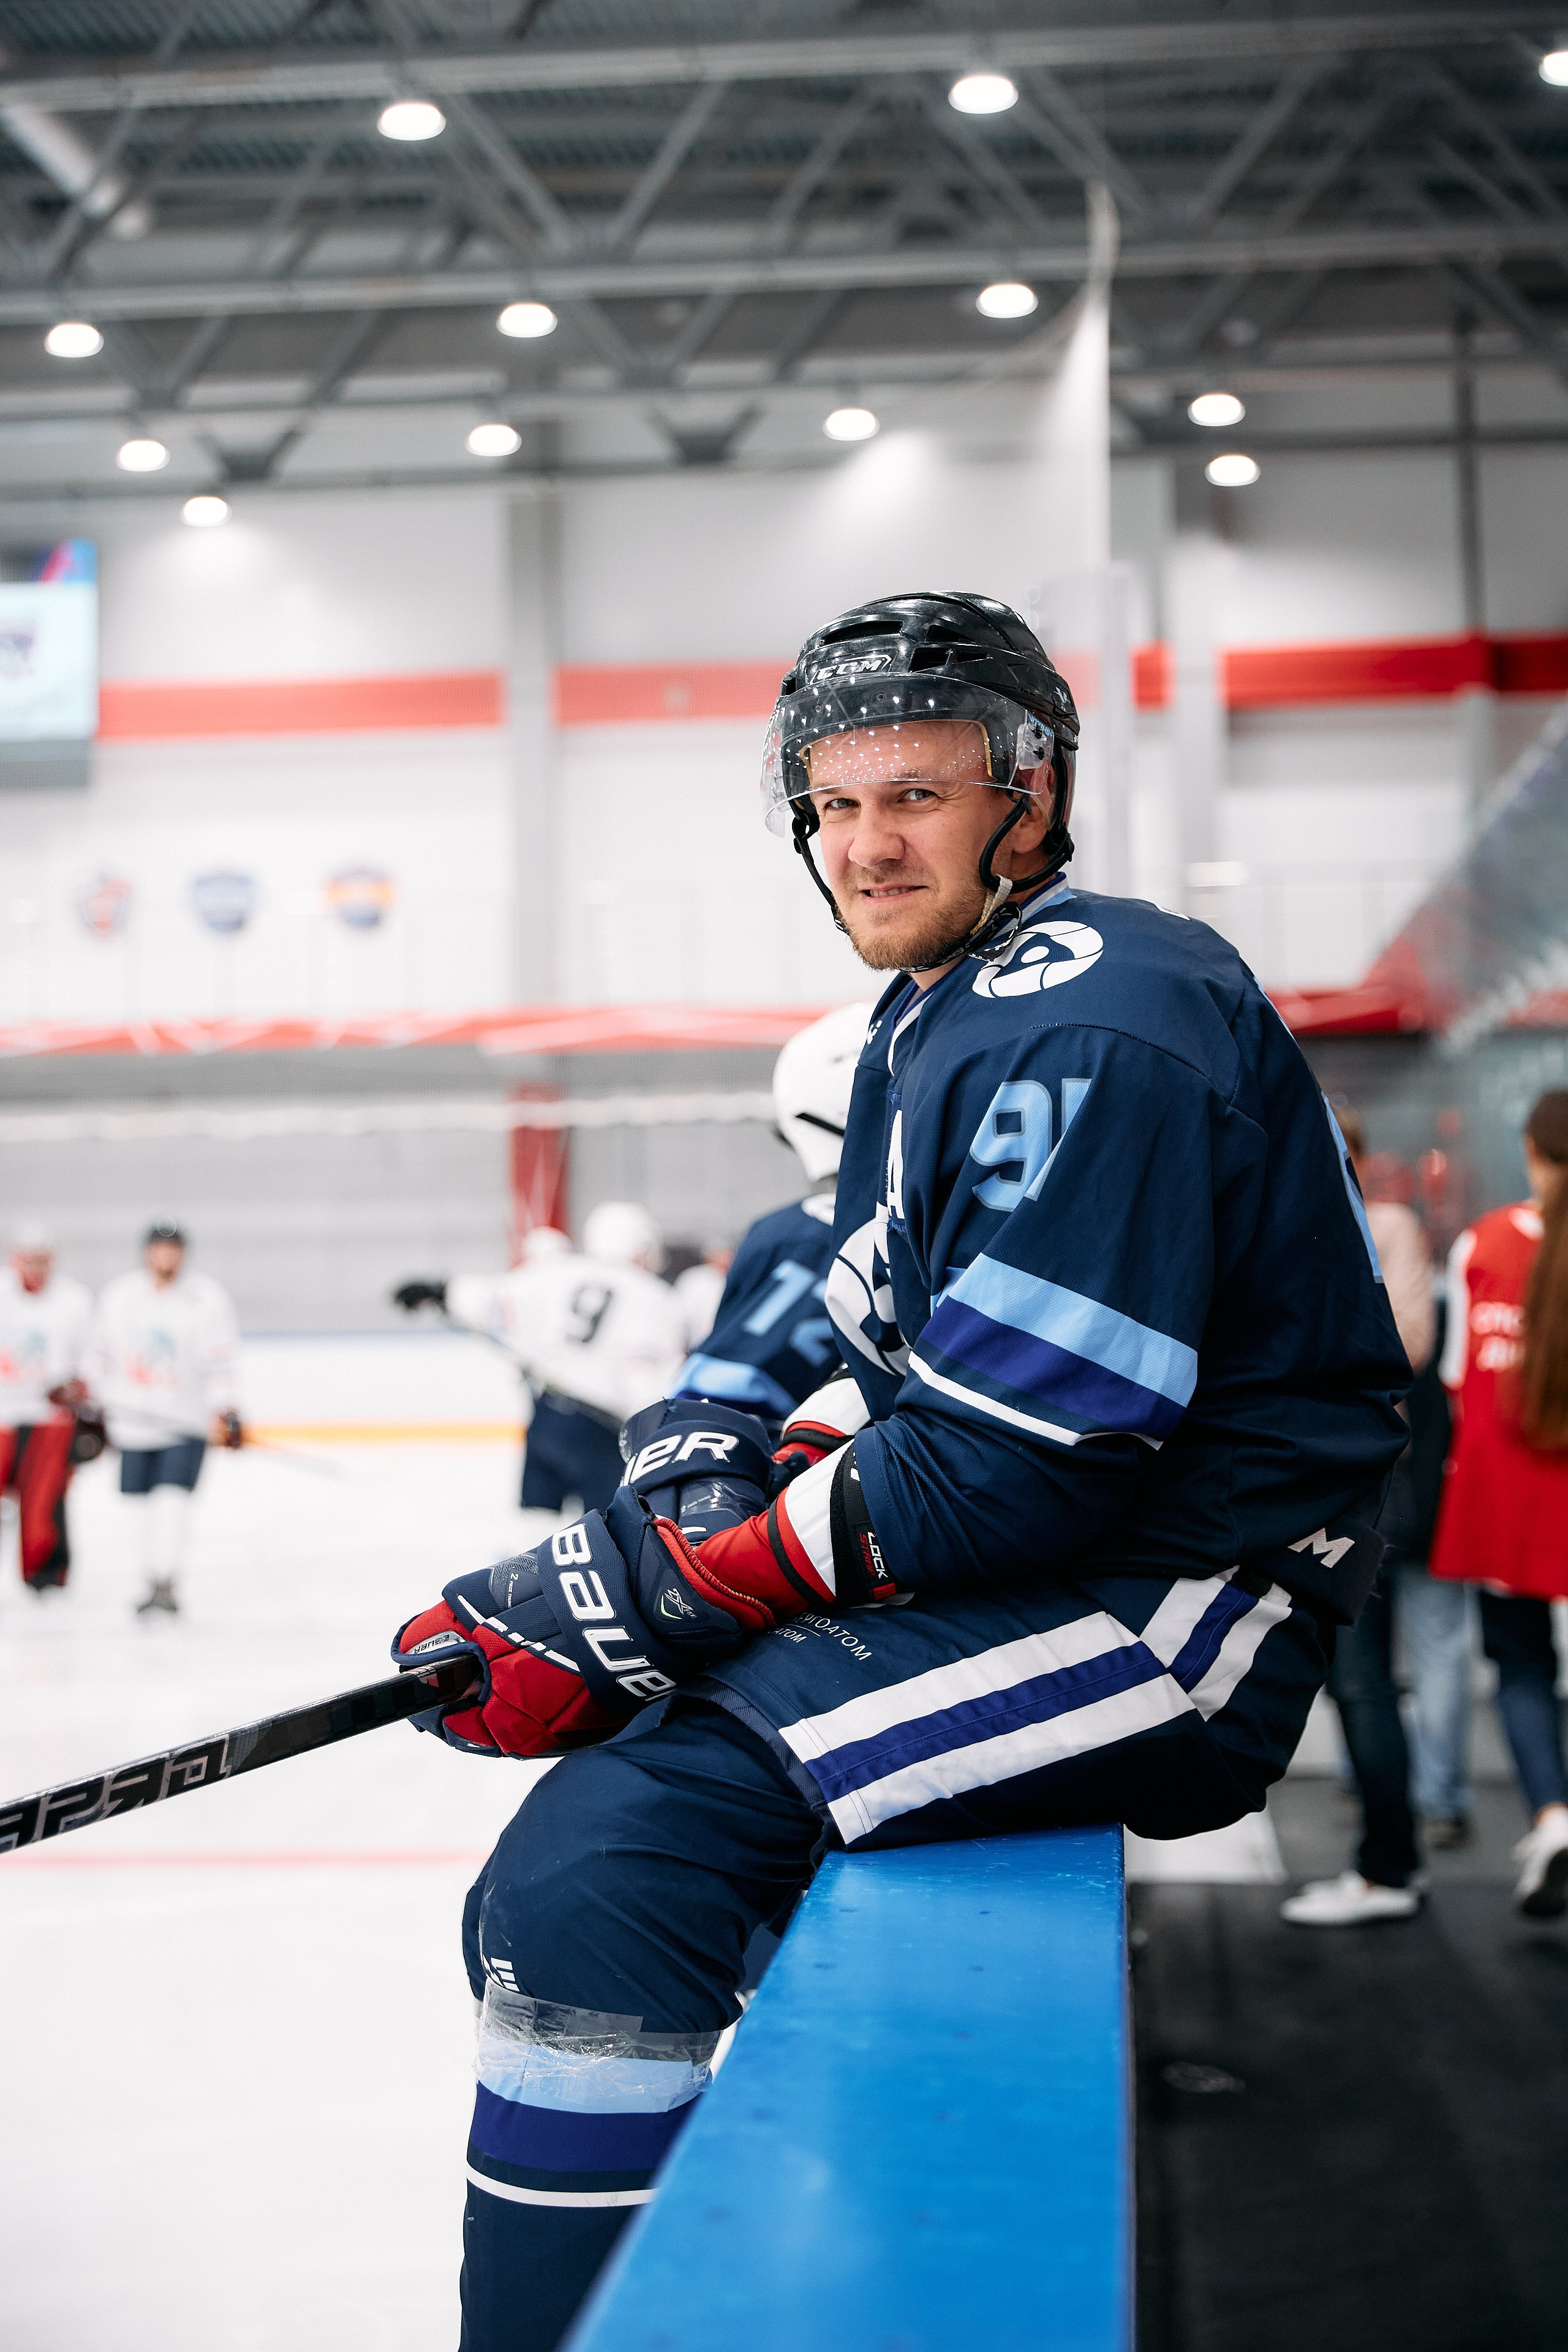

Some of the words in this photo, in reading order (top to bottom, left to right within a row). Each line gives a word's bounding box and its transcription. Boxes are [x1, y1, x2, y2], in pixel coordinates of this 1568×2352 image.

[565, 1284, 614, 1344] 9
[859, 1533, 876, 1577] STRAP
[867, 1531, 888, 1579] LOCK
[552, 1523, 676, 1702] BAUE
[791, 1612, 872, 1660] ЕРГОАТОМ
